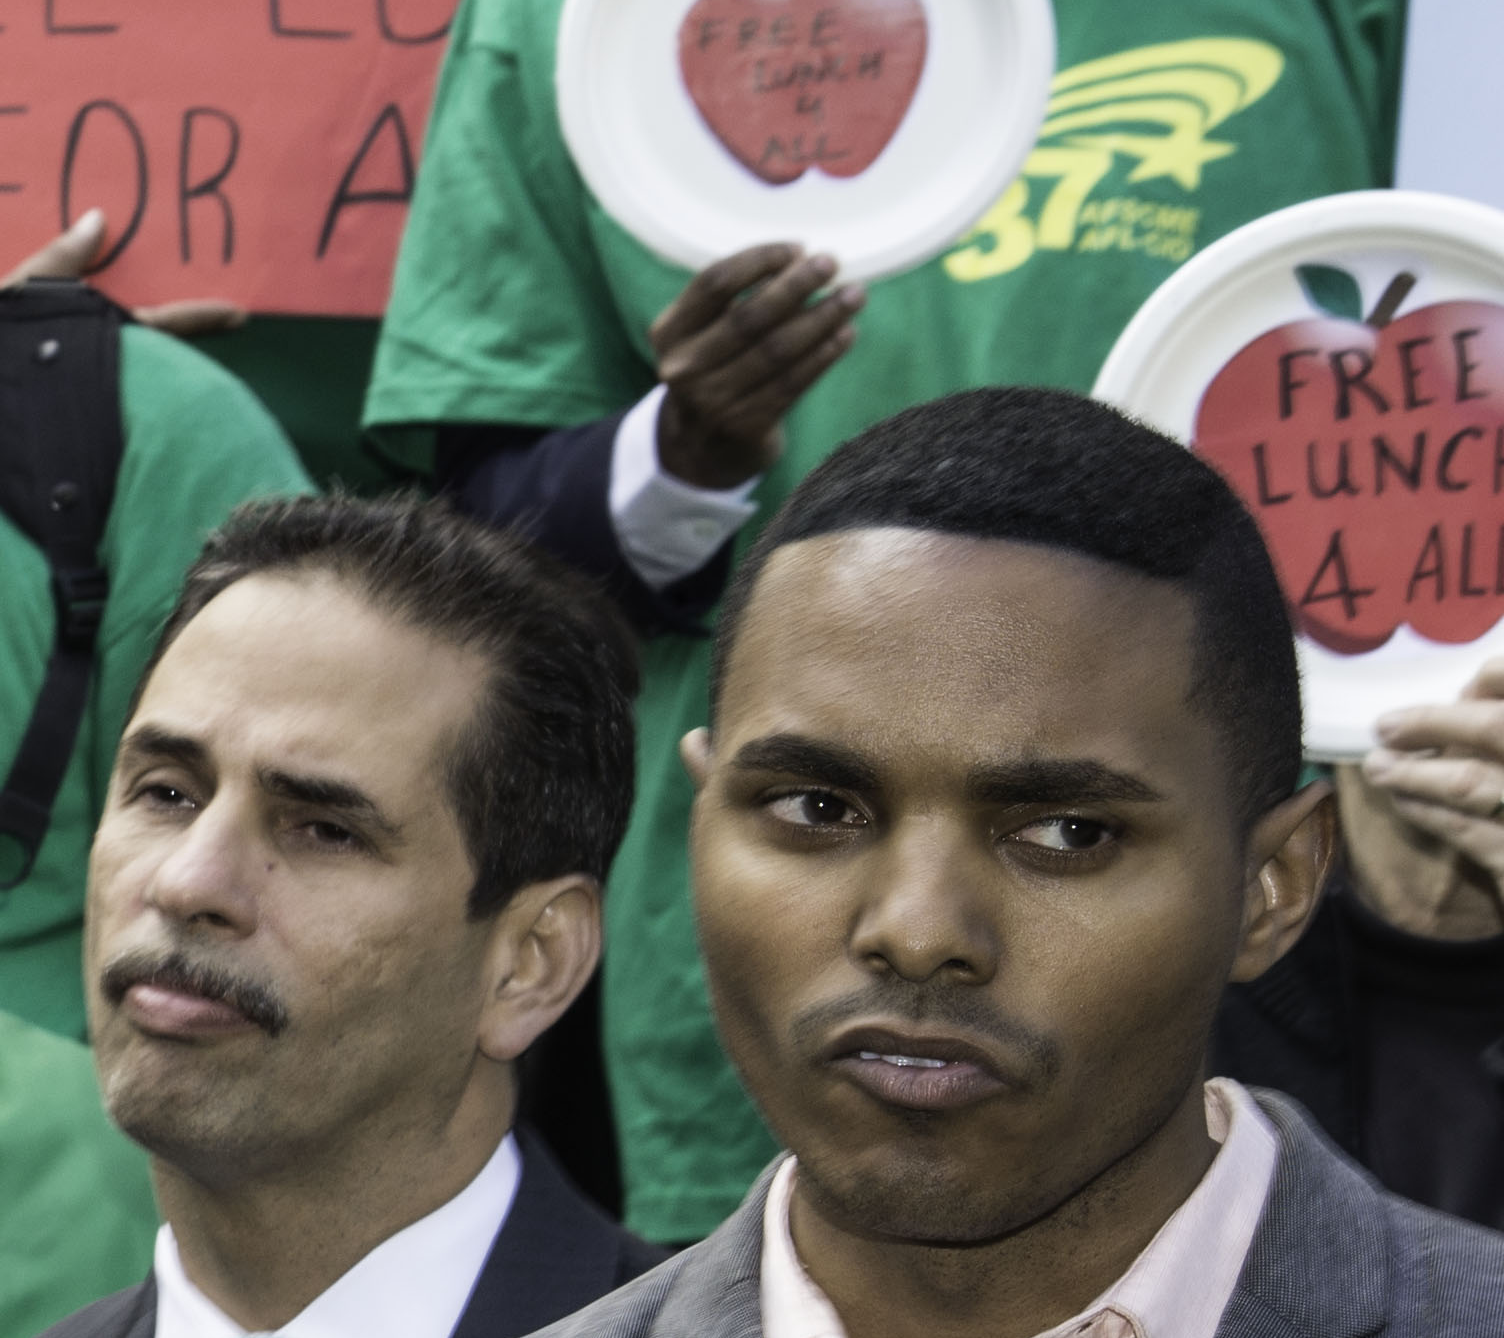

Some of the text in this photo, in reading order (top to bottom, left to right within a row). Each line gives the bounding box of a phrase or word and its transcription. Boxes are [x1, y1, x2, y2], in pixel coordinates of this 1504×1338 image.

[696, 6, 843, 53] FREE
[1277, 327, 1491, 422] FREE
[1299, 528, 1377, 621] 4
